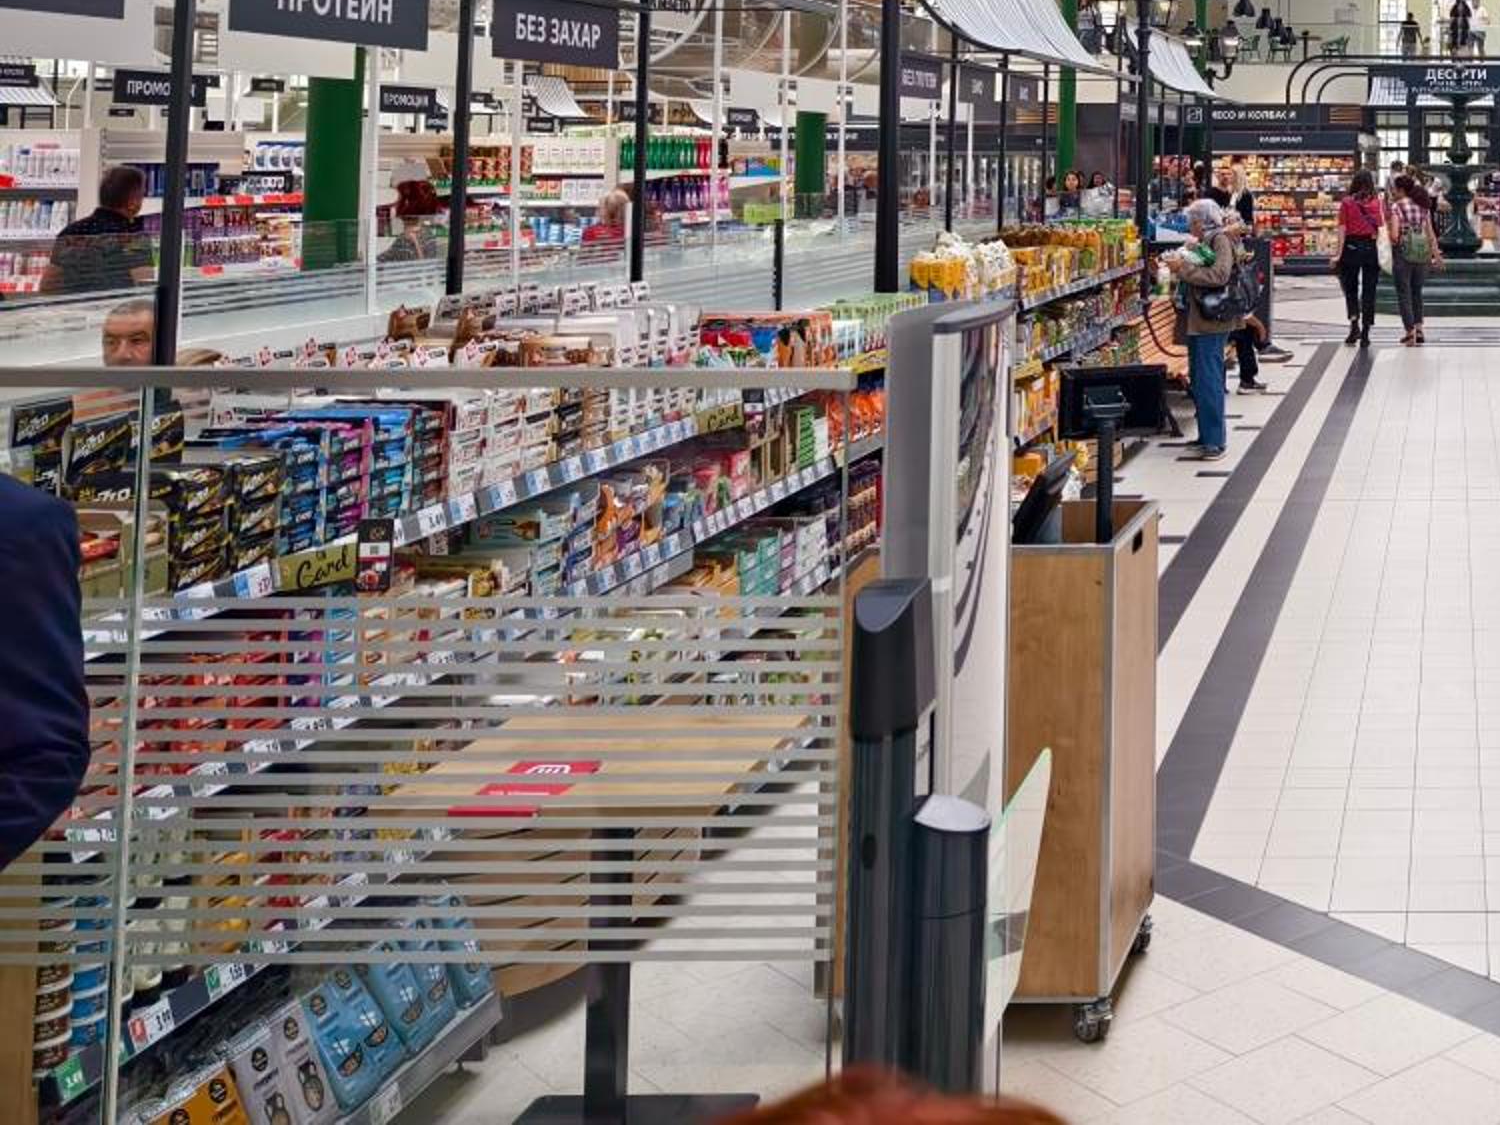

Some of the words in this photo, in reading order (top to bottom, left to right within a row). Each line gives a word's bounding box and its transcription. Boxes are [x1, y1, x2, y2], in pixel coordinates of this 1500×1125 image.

[515, 12, 546, 43] БЕЗ
[549, 18, 601, 50] ЗАХАР
[297, 545, 350, 588] Card
